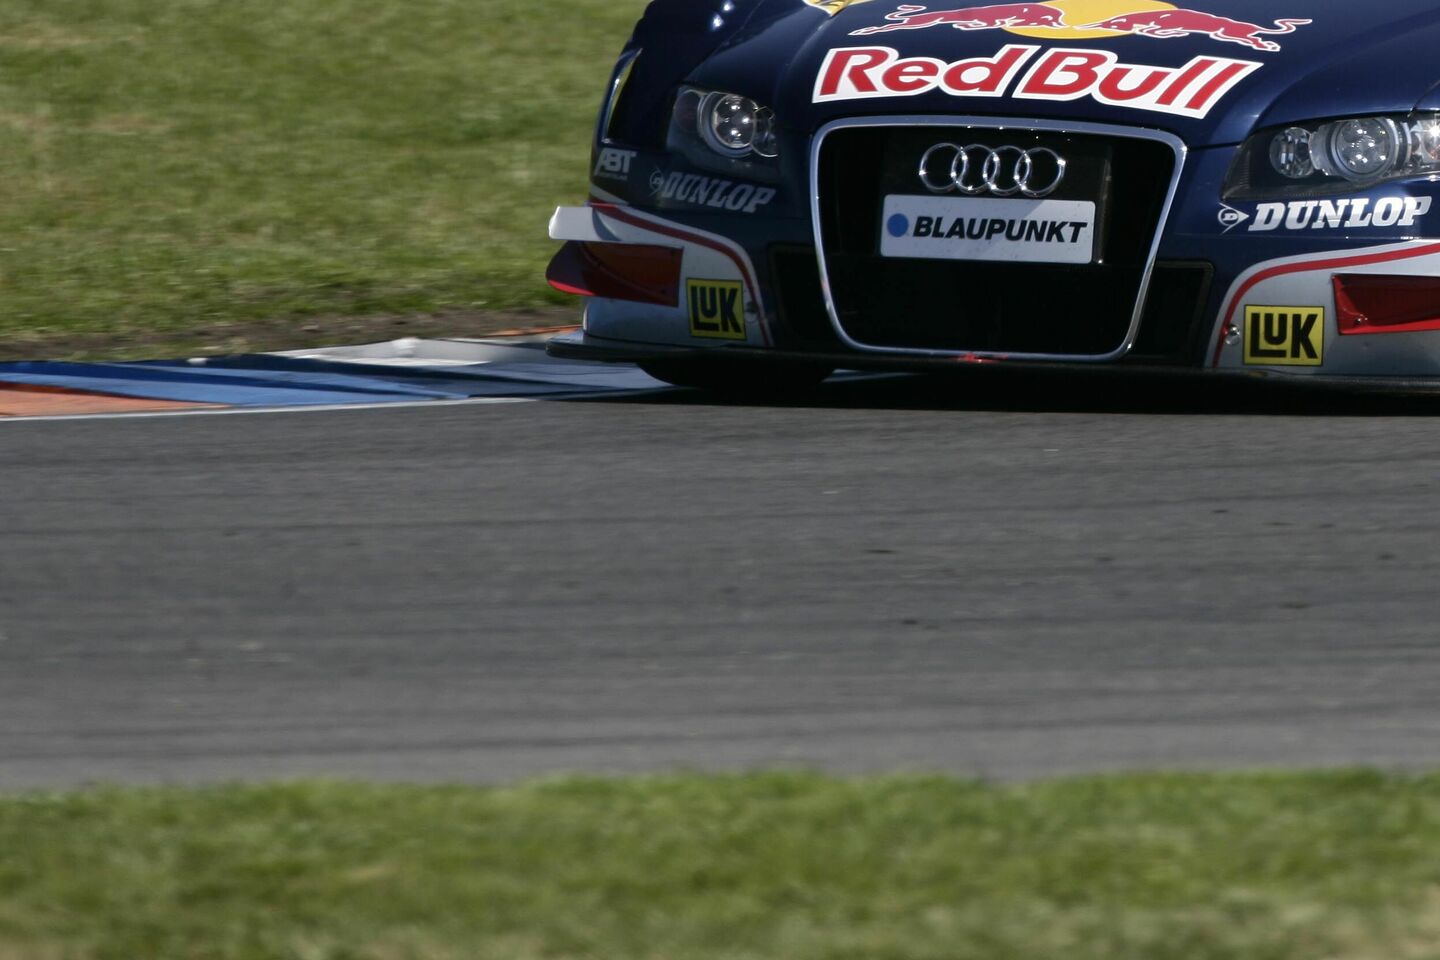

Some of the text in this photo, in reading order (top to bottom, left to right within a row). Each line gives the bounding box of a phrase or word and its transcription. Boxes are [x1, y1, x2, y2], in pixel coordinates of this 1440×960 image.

[814, 45, 1258, 116] Red Bull
[594, 147, 638, 176] ABT
[661, 171, 777, 213] DUNLOP
[913, 216, 1088, 243] BLAUPUNKT
[1248, 196, 1432, 231] DUNLOP
